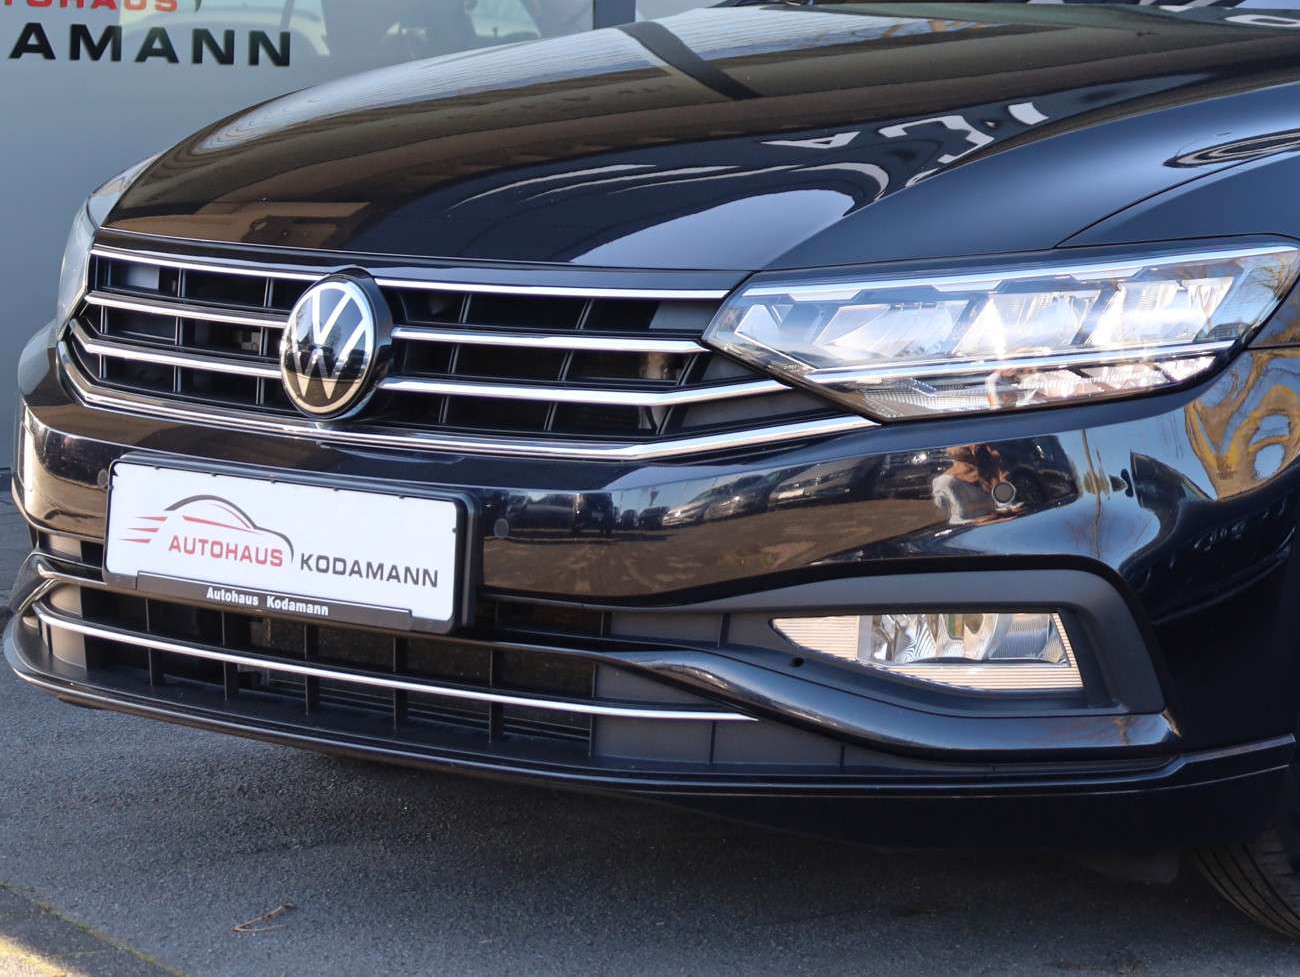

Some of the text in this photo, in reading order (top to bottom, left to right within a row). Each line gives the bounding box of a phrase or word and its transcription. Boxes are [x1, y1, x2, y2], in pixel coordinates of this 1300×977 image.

[8, 22, 291, 67] AMANN
[168, 534, 438, 588] AUTOHAUS KODAMANN
[206, 587, 329, 616] Autohaus Kodamann
